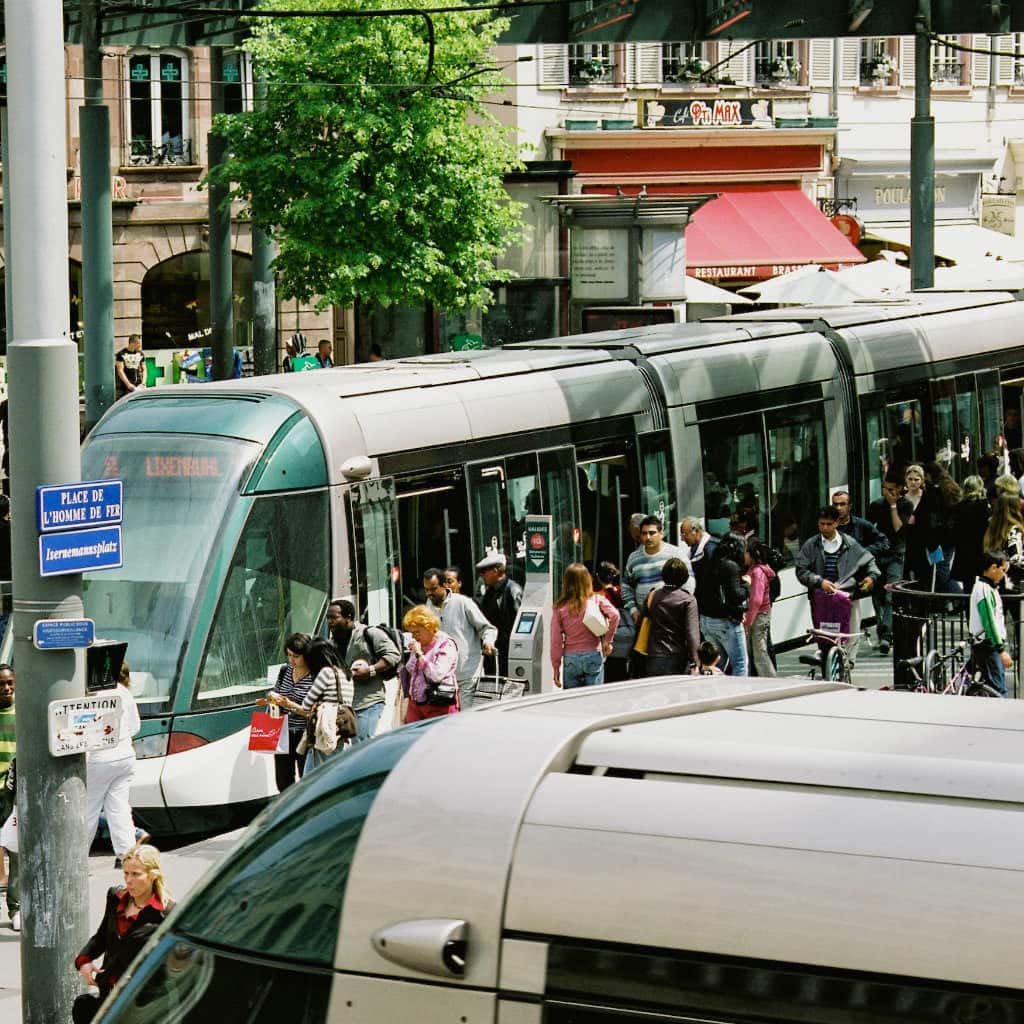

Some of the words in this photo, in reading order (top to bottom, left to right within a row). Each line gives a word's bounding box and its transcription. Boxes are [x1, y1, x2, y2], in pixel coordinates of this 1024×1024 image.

[713, 100, 742, 125] MAX
[695, 266, 757, 278] RESTAURANT
[61, 490, 88, 505] PLACE
[92, 488, 103, 502] DE
[44, 507, 86, 525] L'HOMME
[90, 505, 101, 519] DE
[106, 503, 120, 517] FER
[46, 540, 117, 561] Isernemannsplatz
